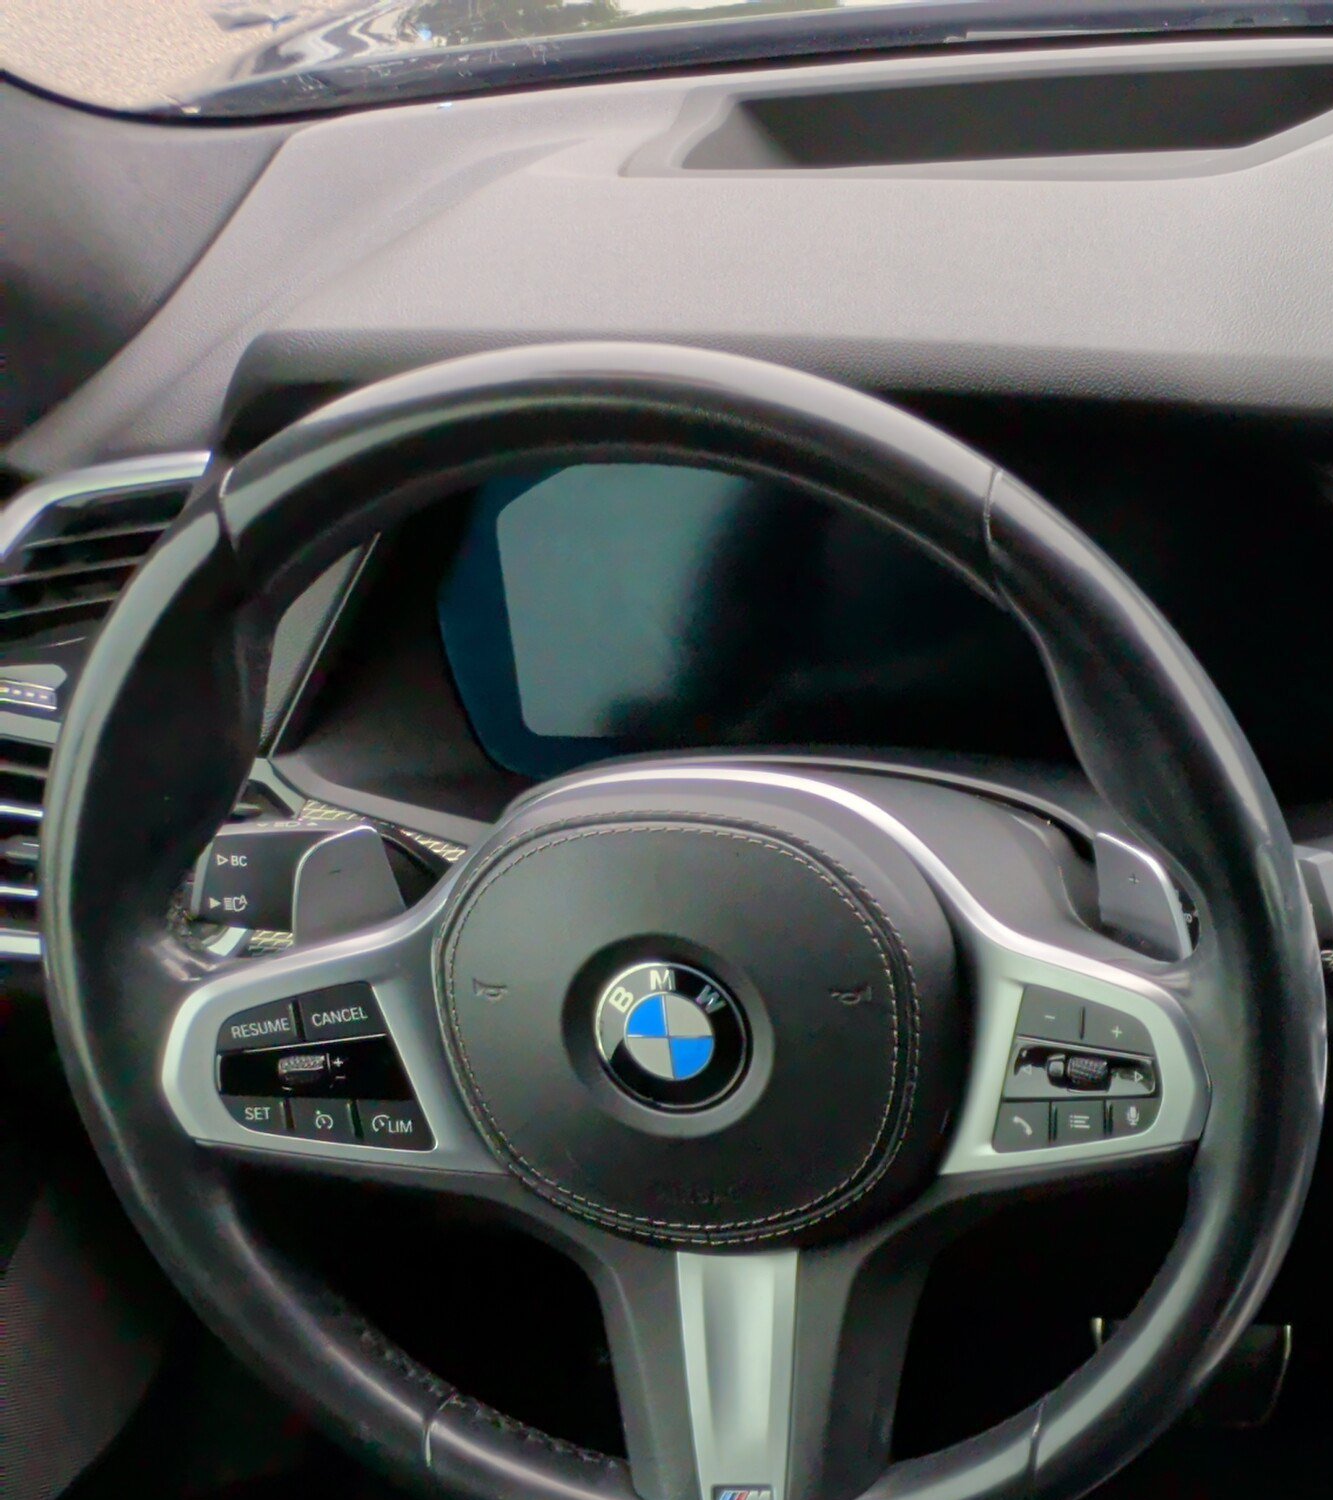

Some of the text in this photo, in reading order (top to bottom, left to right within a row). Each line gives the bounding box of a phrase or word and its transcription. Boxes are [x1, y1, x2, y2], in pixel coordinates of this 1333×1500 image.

[230, 855, 248, 867] BC
[607, 968, 727, 1015] BMW
[310, 1006, 369, 1027] CANCEL
[230, 1017, 291, 1039] RESUME
[244, 1106, 271, 1121] SET
[387, 1119, 414, 1134] LIM
